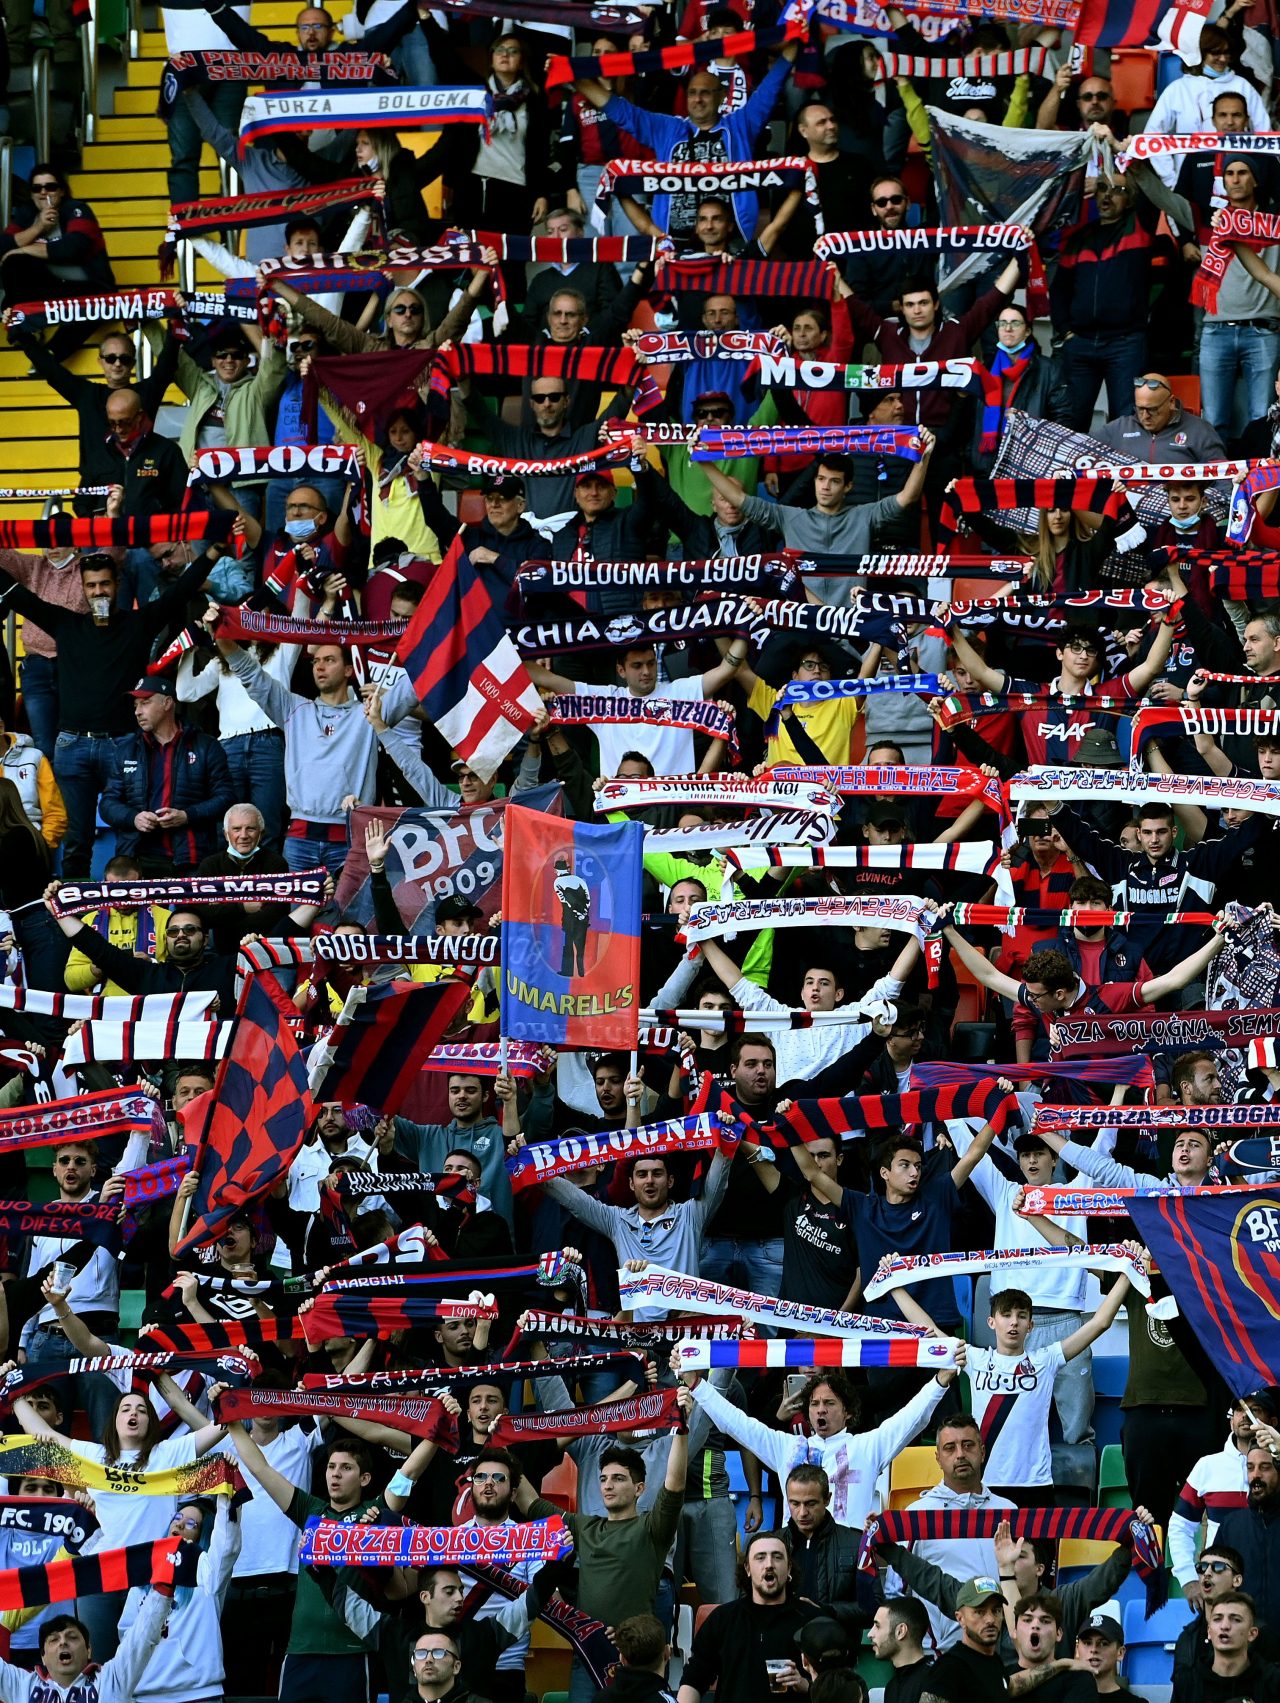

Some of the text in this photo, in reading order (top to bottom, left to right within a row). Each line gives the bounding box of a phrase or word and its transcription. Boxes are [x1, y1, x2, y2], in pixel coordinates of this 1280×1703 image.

[171, 51, 386, 72] IN PRIMA LINEA
[208, 65, 374, 81] SEMPRE NOI
[265, 92, 470, 115] FORZA BOLOGNA
[614, 156, 807, 176] VECCHIA GUARDIA
[643, 172, 784, 192] BOLOGNA
[816, 226, 969, 260] BOLOGNA FC
[44, 291, 166, 324] BOLOGNA FC
[195, 292, 226, 302] PUB
[229, 305, 258, 319] TEN
[848, 377, 892, 386] 19 82
[720, 427, 897, 458] BOLOGNA
[1097, 463, 1240, 480] BOLOGNA
[553, 554, 761, 586] BOLOGNA FC 1909
[240, 609, 326, 635] BOLOGNESI
[764, 602, 864, 637] ARE ONE
[479, 676, 523, 721] 1909 2009
[559, 696, 729, 733] FORZA BOLOGNA
[1037, 722, 1096, 742] FAAC
[638, 780, 800, 797] LA STORIA SIAMO NOI
[773, 770, 960, 787] FOREVER ULTRAS
[390, 807, 505, 884] BFC
[57, 877, 321, 904] Bologna is Magic
[422, 861, 495, 900] 1909
[315, 934, 419, 962] FC 1909
[1078, 1108, 1153, 1128] FORZA
[528, 1112, 713, 1172] BOLOGNA
[536, 1145, 667, 1181] FOOTBALL CLUB
[43, 1202, 121, 1222] ONORE
[20, 1215, 84, 1235] DIFESA
[337, 1274, 406, 1291] MARGINI
[525, 1311, 619, 1340] OLOGNA
[399, 1398, 432, 1421] NOI
[591, 1393, 665, 1424] SIAMO NOI
[103, 1465, 147, 1485] BFC
[109, 1481, 140, 1494] 1909
[0, 1507, 86, 1545] F.C. 1909
[312, 1525, 548, 1554] FORZA BOLOGNA
[305, 1550, 554, 1562] GLORIOSI NOSTRI COLORI SPLENDERANNO SEMPRE
